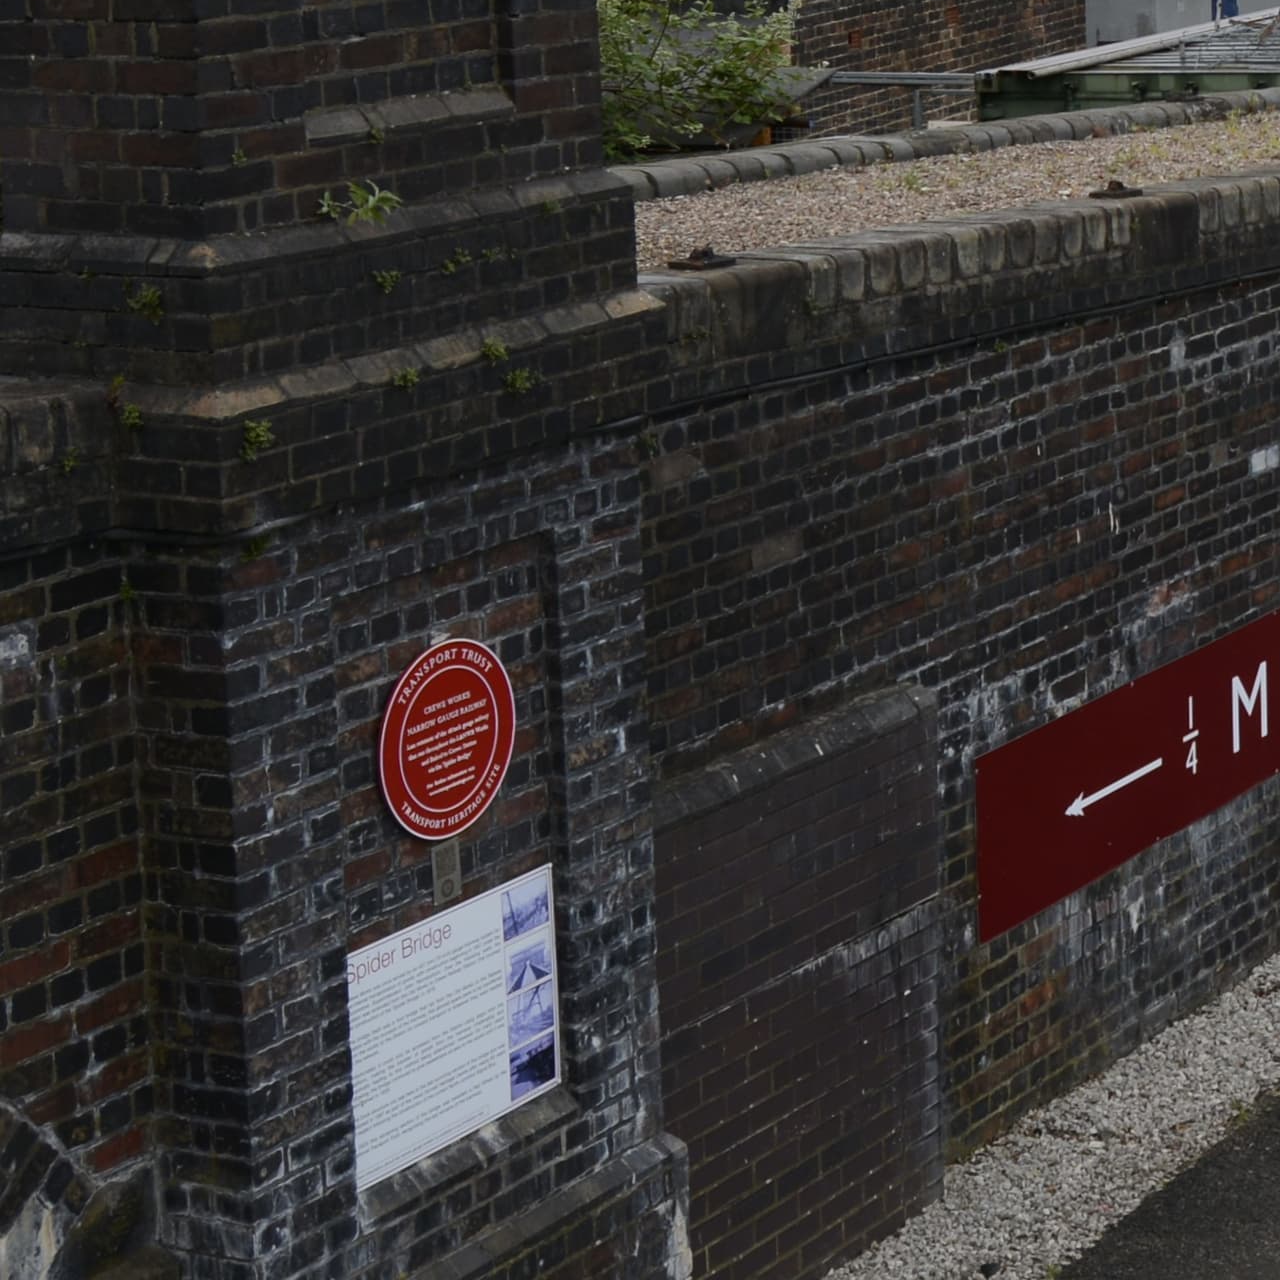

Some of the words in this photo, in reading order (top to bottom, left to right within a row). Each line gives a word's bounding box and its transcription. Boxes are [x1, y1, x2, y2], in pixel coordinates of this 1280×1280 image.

[398, 648, 459, 705] TRANSPORT
[461, 648, 494, 673] TRUST
[401, 801, 447, 829] TRANSPORT
[447, 790, 486, 827] HERITAGE
[485, 763, 500, 789] SITE
[346, 948, 396, 985] Spider
[401, 923, 452, 959] Bridge
